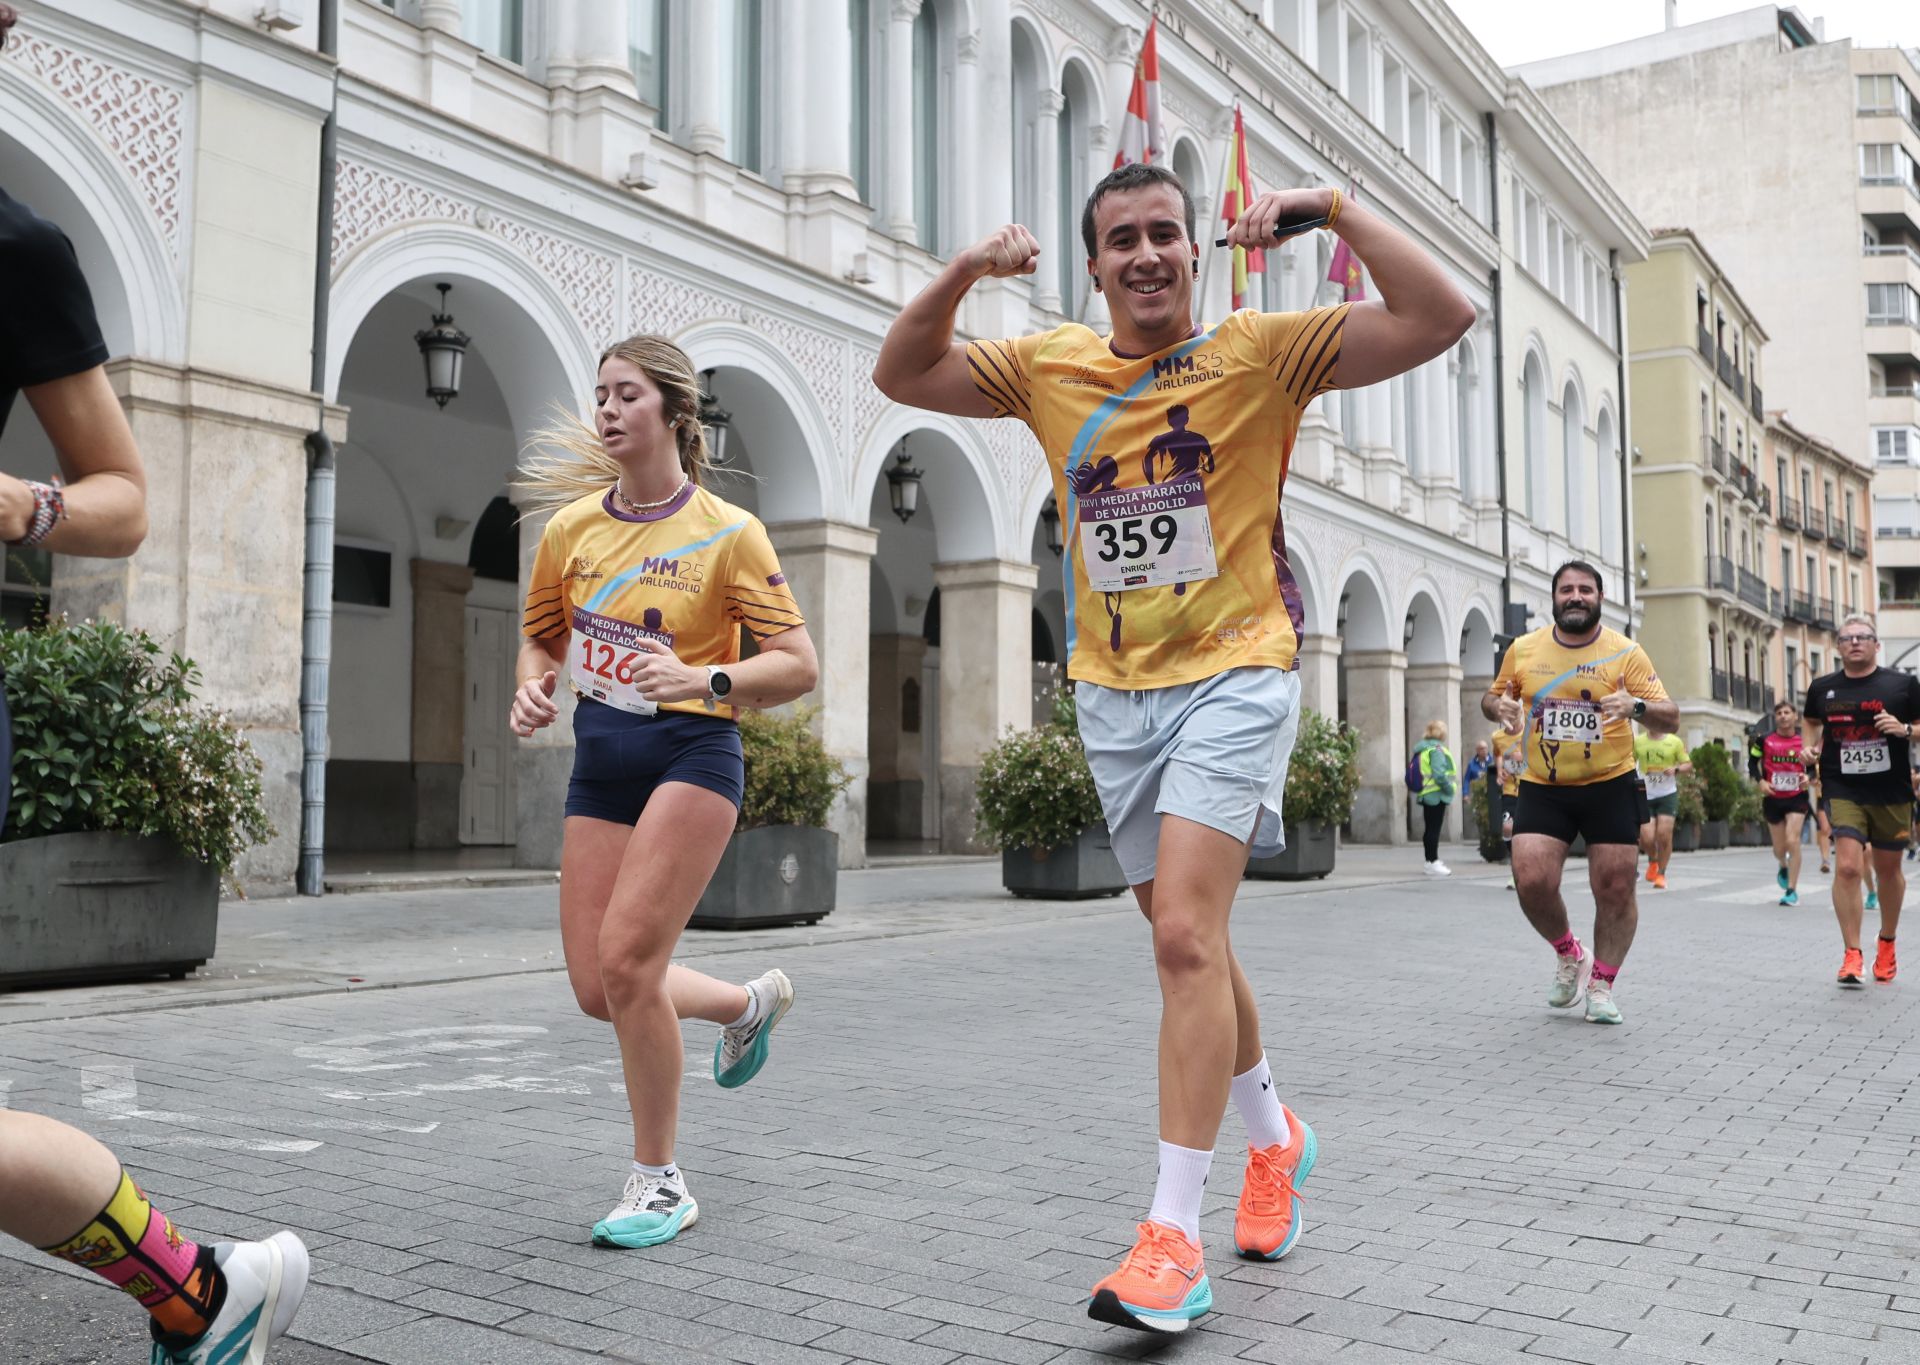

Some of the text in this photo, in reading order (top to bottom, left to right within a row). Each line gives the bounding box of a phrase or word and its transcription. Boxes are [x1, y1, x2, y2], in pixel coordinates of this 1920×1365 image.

[1152, 351, 1223, 379] MM25
[1155, 369, 1224, 391] VALLADOLID
[1101, 492, 1139, 506] MEDIA
[1142, 480, 1201, 500] MARATÓN
[1095, 497, 1187, 520] DE VALLADOLID
[1095, 514, 1178, 562] 359
[641, 557, 705, 582] MM25
[1120, 562, 1157, 574] ENRIQUE
[640, 576, 701, 593] VALLADOLID
[585, 625, 654, 652] DE VALLADO
[591, 617, 621, 632] MEDIA
[623, 626, 672, 646] MARATÓN
[582, 638, 640, 685] 126
[1548, 711, 1597, 730] 1808
[1843, 749, 1884, 764] 2453
